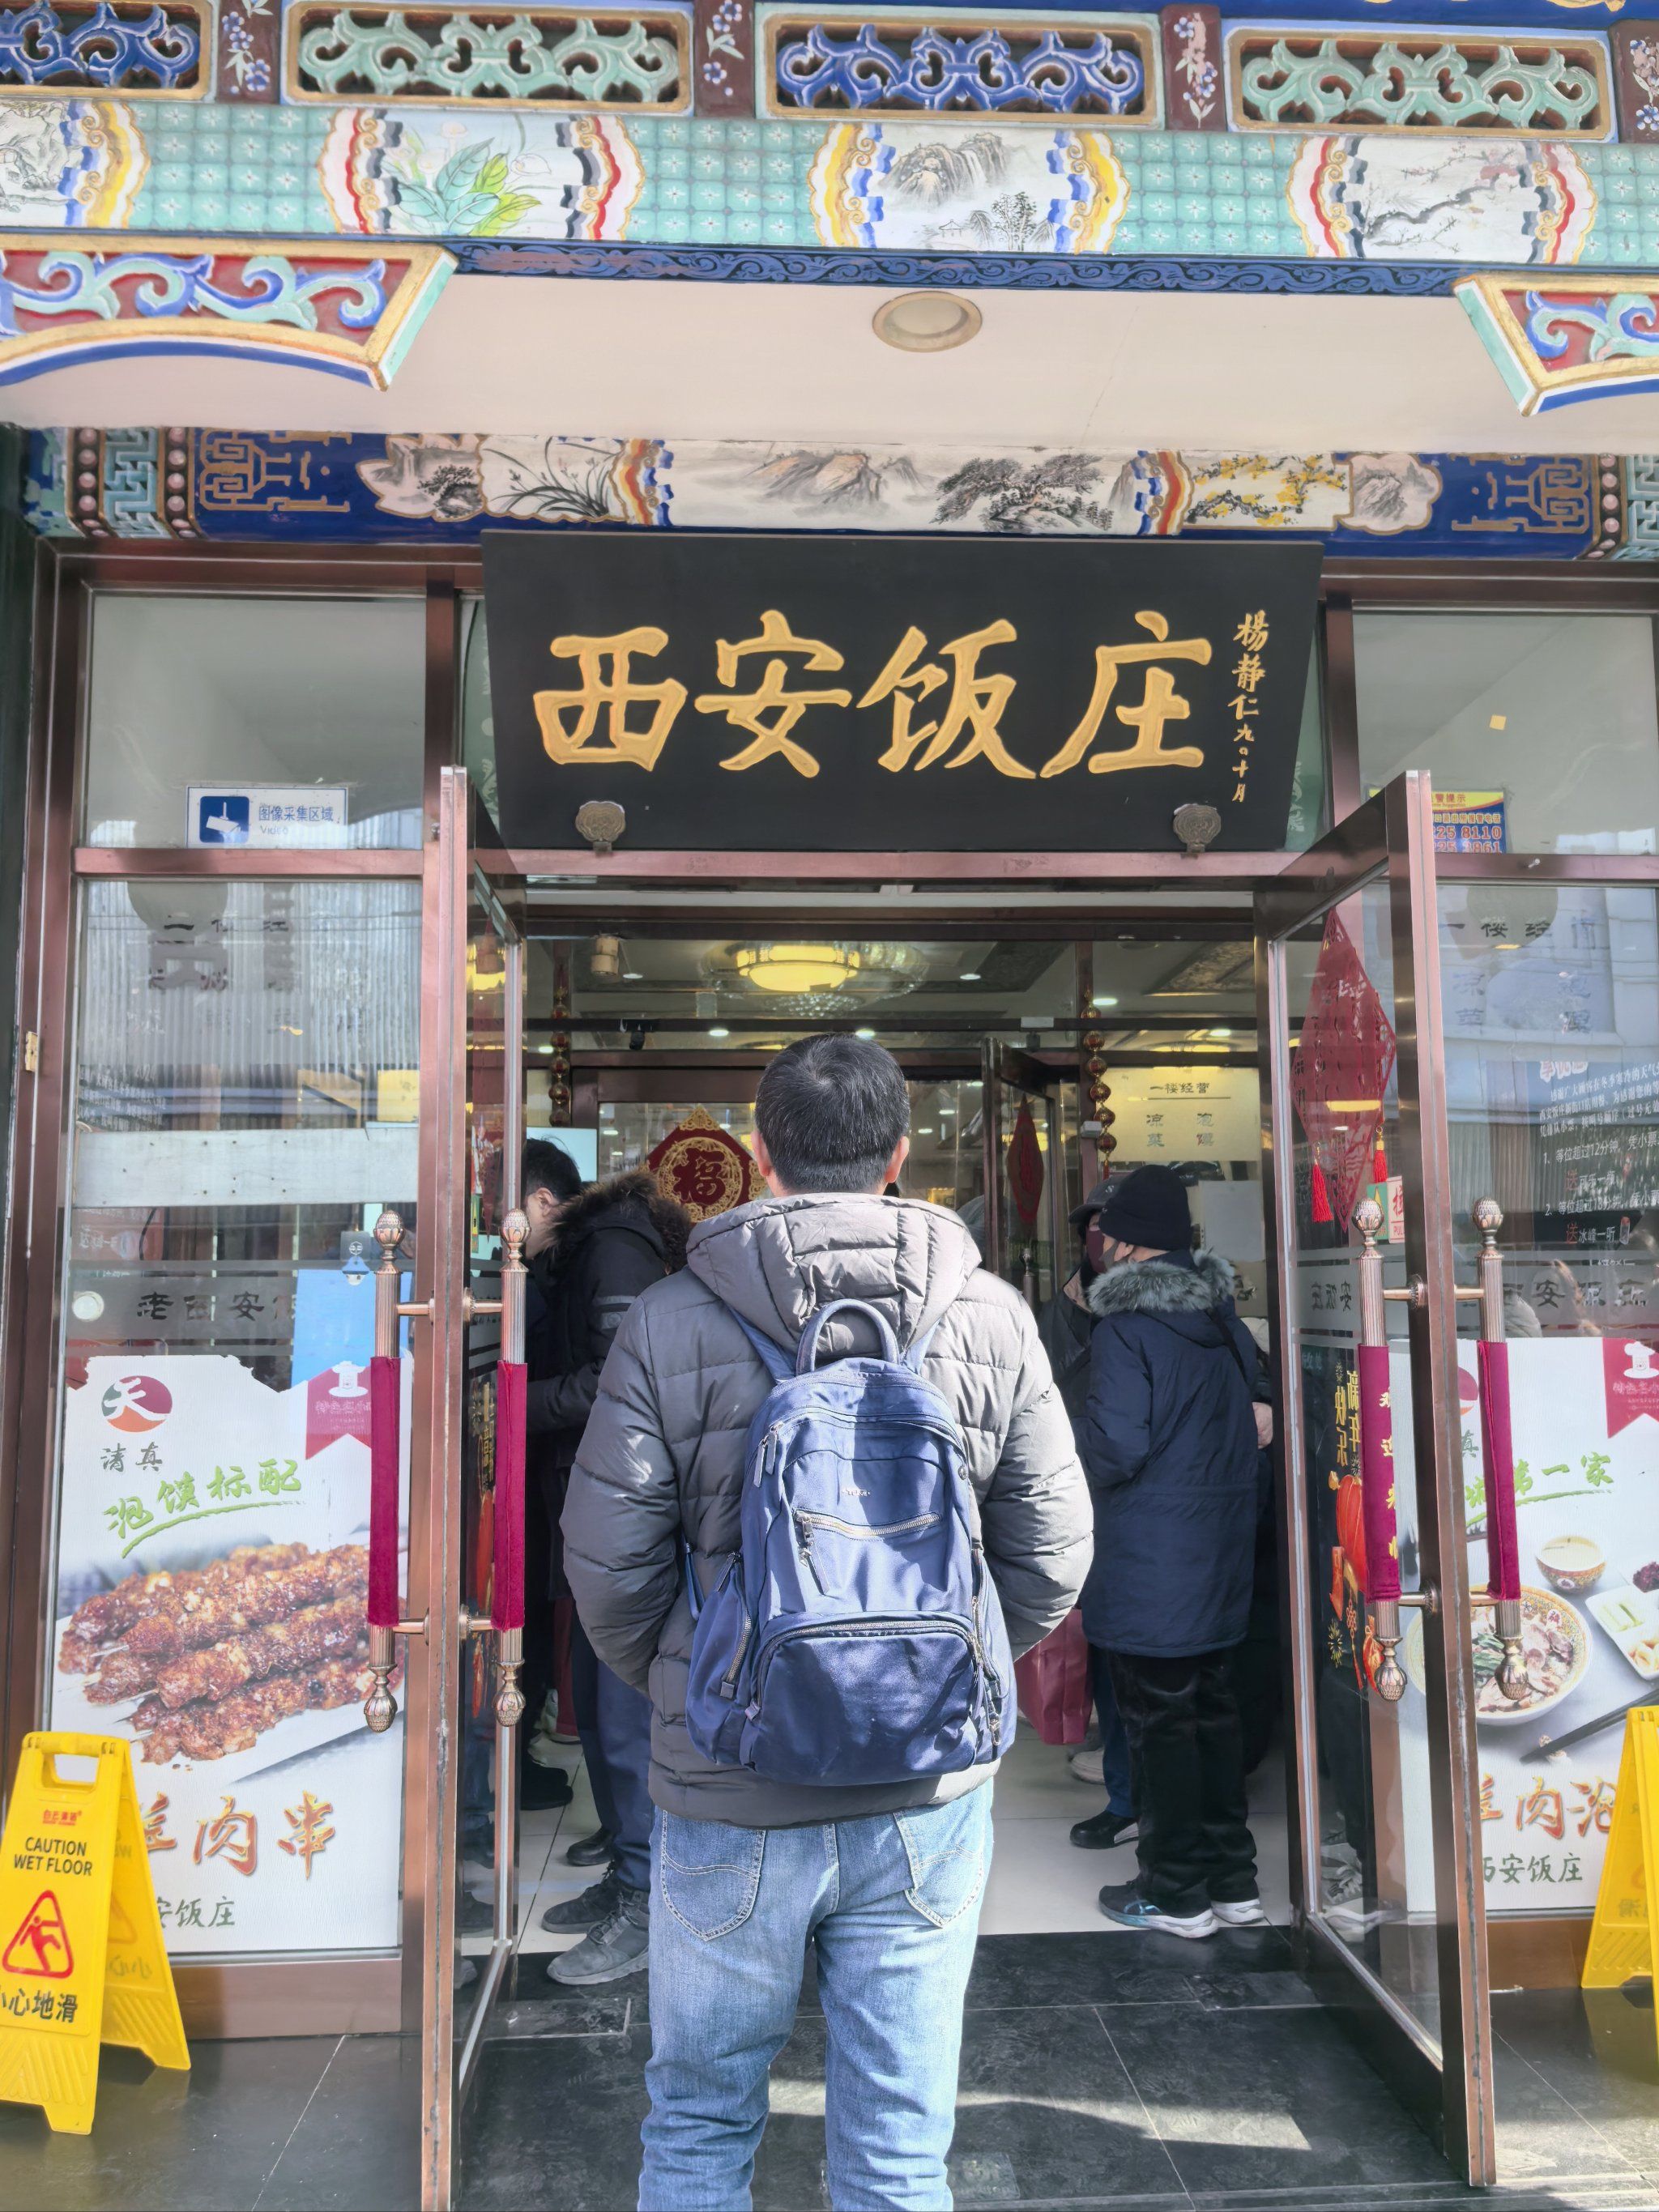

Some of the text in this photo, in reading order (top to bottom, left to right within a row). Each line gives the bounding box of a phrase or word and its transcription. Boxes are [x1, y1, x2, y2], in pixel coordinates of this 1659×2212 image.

[533, 611, 1211, 778] 西安饭庄
[259, 806, 334, 821] 图像采集区域
[1461, 825, 1502, 840] 8110
[1149, 1082, 1210, 1094] 一楼经营
[672, 1147, 726, 1205] 福
[100, 1441, 163, 1472] 清真
[103, 1458, 302, 1539] 泡馍标配
[25, 1836, 87, 1856] CAUTION
[14, 1854, 93, 1877] WET FLOOR
